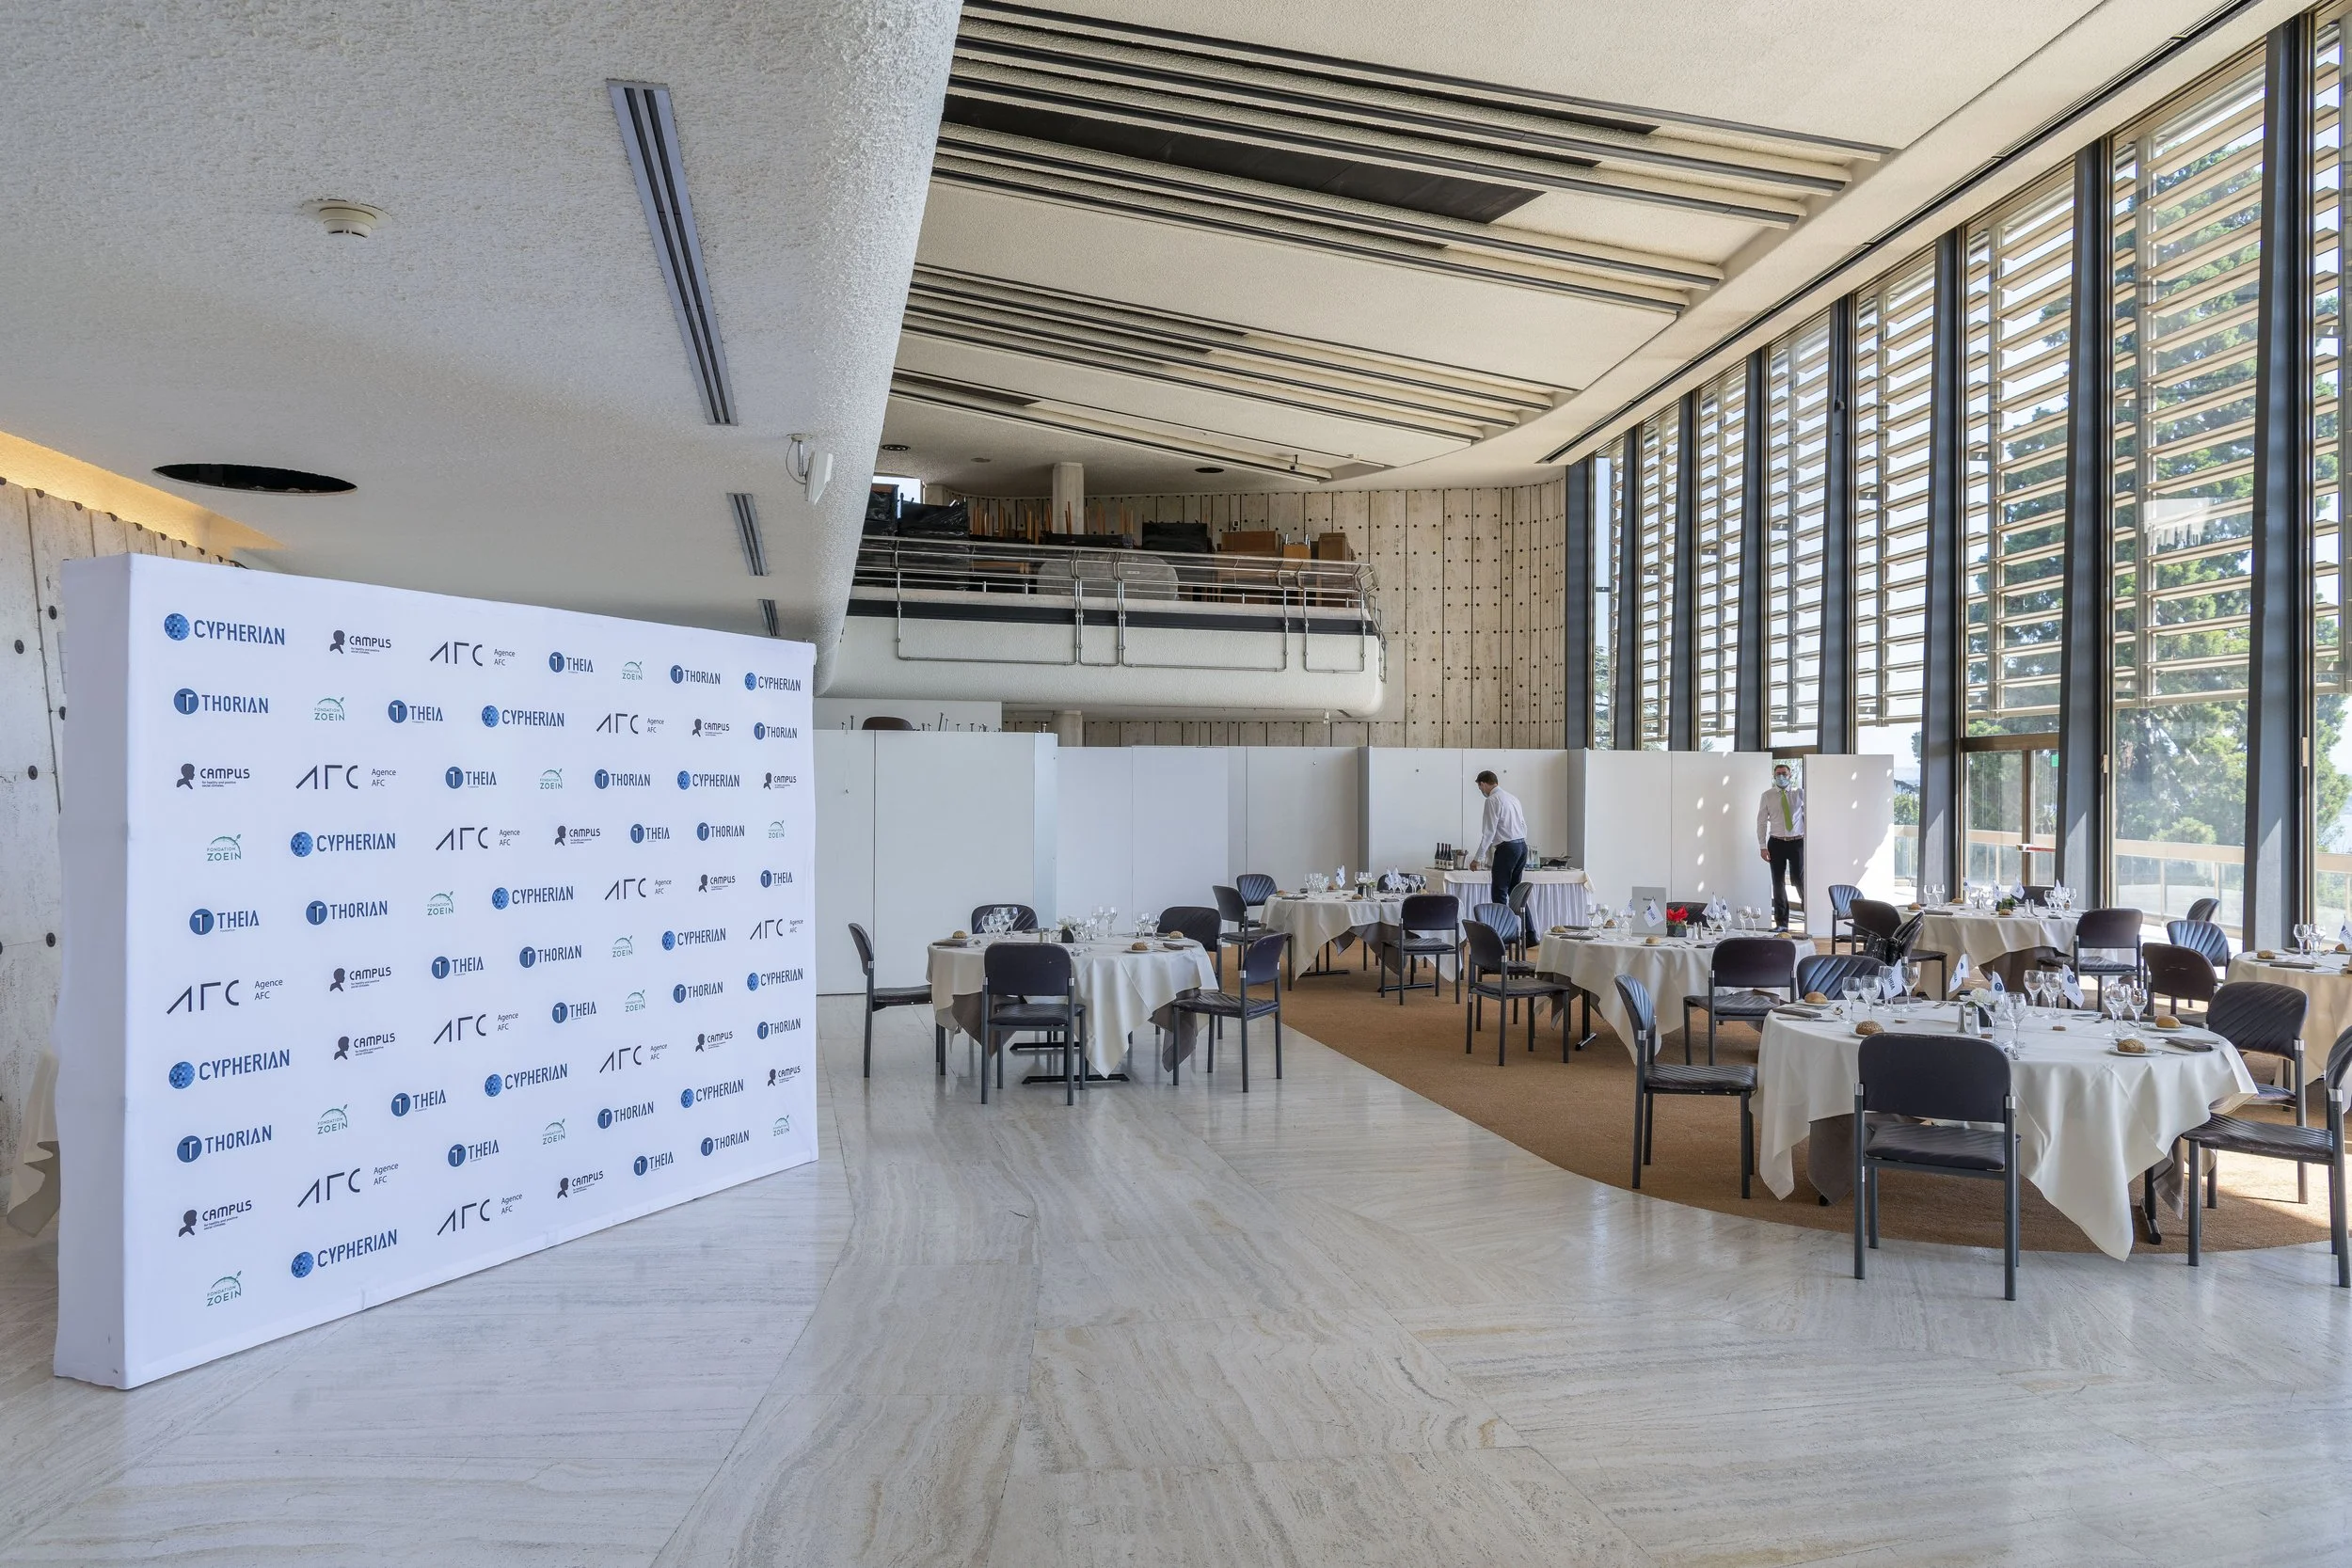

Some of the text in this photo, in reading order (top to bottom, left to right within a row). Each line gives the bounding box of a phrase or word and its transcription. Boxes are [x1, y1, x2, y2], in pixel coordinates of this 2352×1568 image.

[194, 619, 285, 646] CYPHERIAN
[494, 648, 516, 657] Agence
[566, 657, 594, 673] THEIA
[685, 669, 721, 685] THORIAN
[758, 676, 802, 692] CYPHERIAN
[201, 694, 268, 714] THORIAN
[410, 705, 443, 721] THEIA
[501, 709, 564, 727] CYPHERIAN
[767, 726, 798, 739] THORIAN
[371, 768, 397, 778] Agence
[465, 770, 497, 785] THEIA
[611, 773, 651, 786] THORIAN
[692, 773, 739, 787] CYPHERIAN
[499, 829, 520, 838] Agence
[645, 826, 670, 840] THEIA
[710, 824, 745, 838] THORIAN
[316, 832, 395, 853] CYPHERIAN
[772, 871, 793, 884] THEIA
[512, 885, 574, 906] CYPHERIAN
[330, 900, 388, 920] THORIAN
[217, 911, 260, 929] THEIA
[677, 927, 726, 947] CYPHERIAN
[537, 944, 581, 963] THORIAN
[452, 956, 484, 974] THEIA
[254, 978, 283, 990] Agence
[760, 968, 803, 988] CYPHERIAN
[688, 981, 723, 999] THORIAN
[497, 1012, 518, 1022] Agence
[569, 1002, 596, 1018] THEIA
[770, 1017, 801, 1036] THORIAN
[199, 1049, 291, 1082] CYPHERIAN
[504, 1063, 567, 1090] CYPHERIAN
[413, 1088, 447, 1110] THEIA
[695, 1079, 744, 1102] CYPHERIAN
[613, 1101, 654, 1124] THORIAN
[205, 1124, 272, 1155] THORIAN
[714, 1129, 750, 1151] THORIAN
[468, 1139, 500, 1160] THEIA
[649, 1150, 674, 1169] THEIA
[373, 1163, 399, 1175] Agence
[501, 1193, 523, 1205] Agence
[317, 1228, 397, 1269] CYPHERIAN
